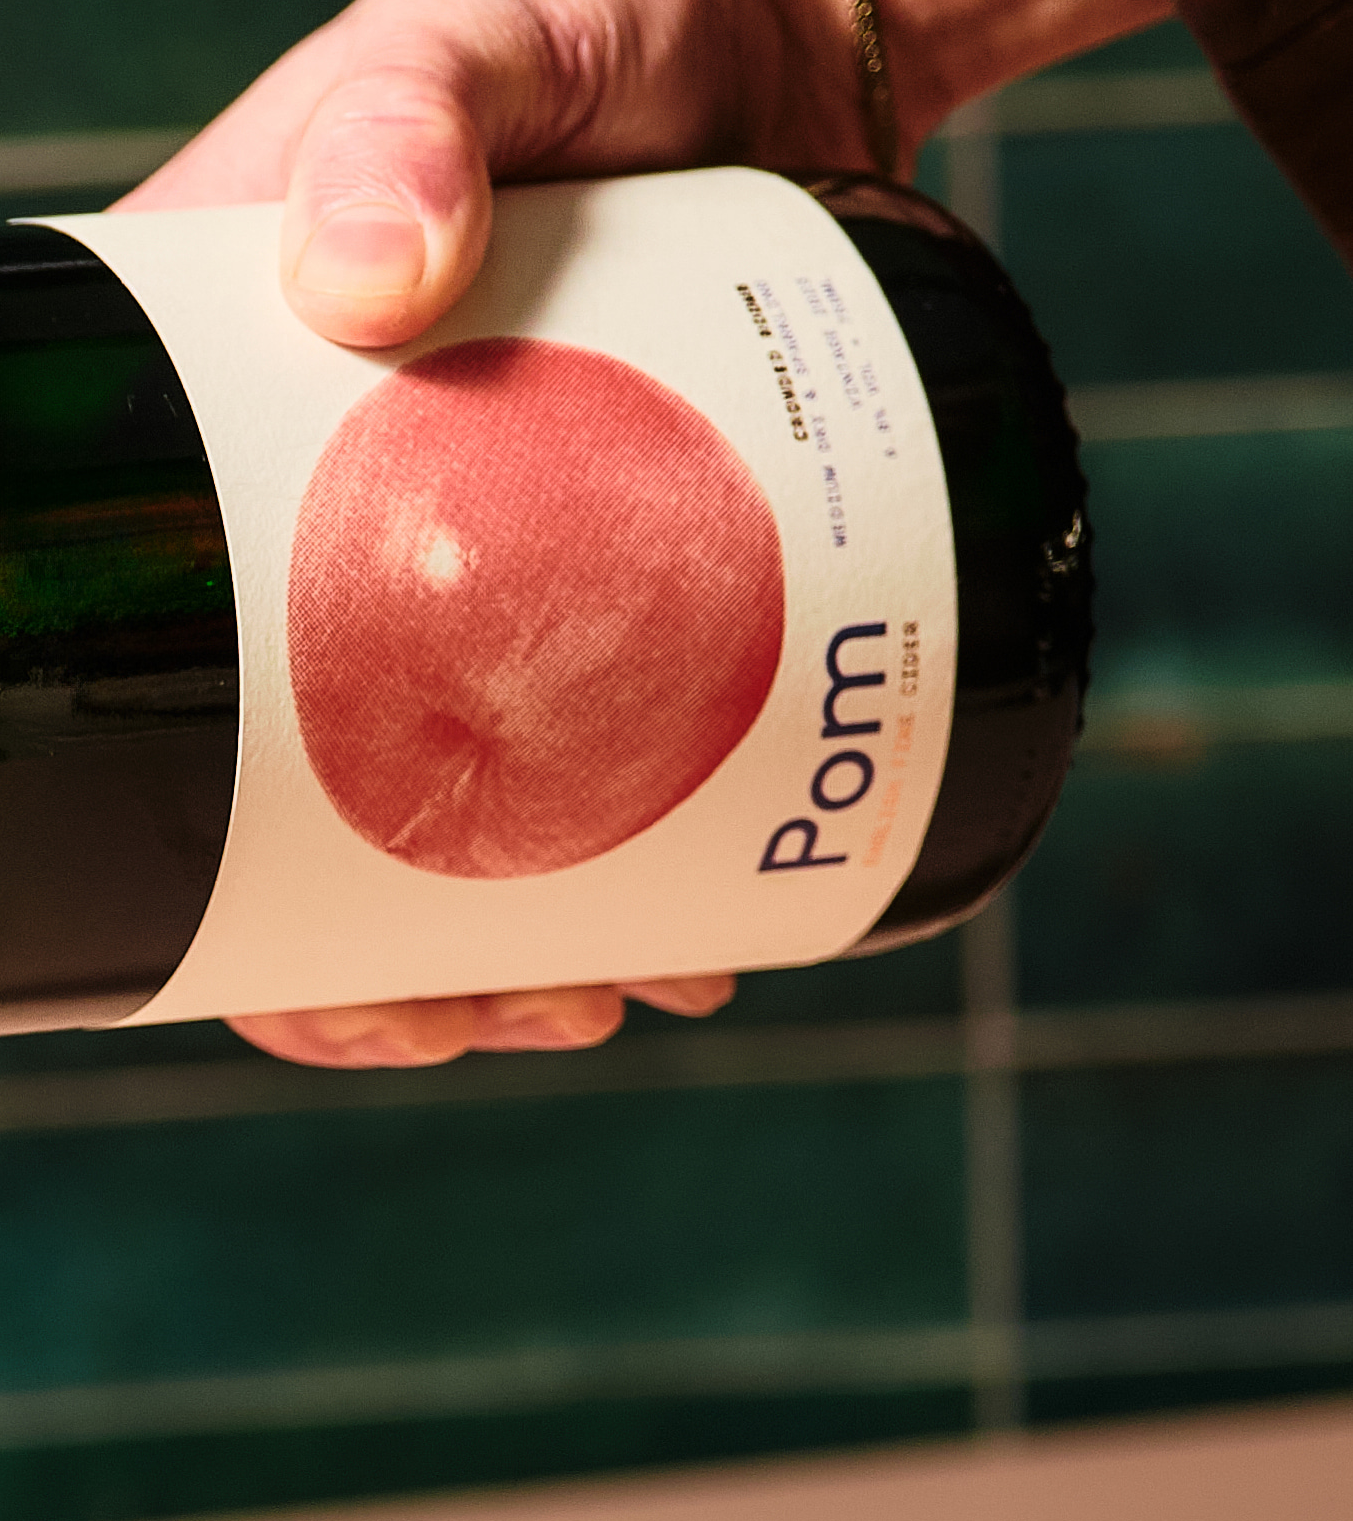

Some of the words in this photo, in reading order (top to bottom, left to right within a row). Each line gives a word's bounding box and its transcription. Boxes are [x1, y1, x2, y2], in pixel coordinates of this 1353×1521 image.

[768, 349, 808, 441] CROWDED
[824, 464, 847, 548] MEDIUM
[898, 620, 920, 697] CIDER
[758, 621, 888, 874] Pom
